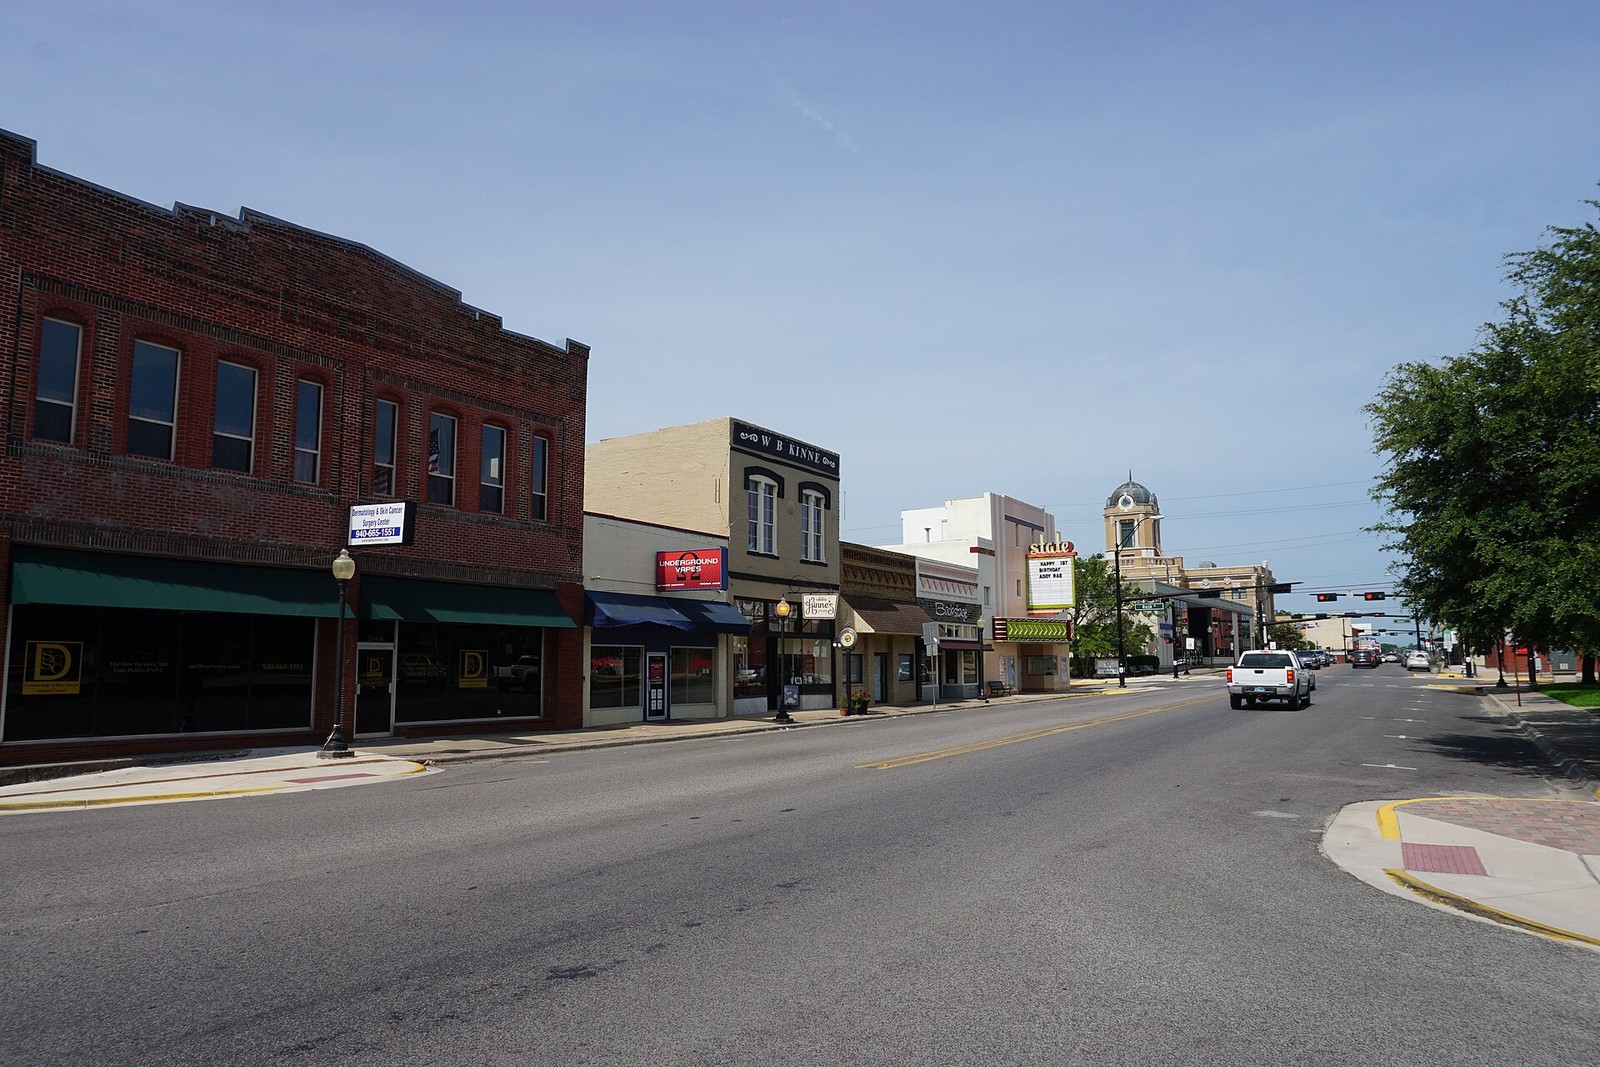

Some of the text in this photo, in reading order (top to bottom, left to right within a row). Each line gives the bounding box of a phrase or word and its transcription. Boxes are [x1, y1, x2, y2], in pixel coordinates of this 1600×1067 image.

[760, 435, 821, 464] W B KINNE
[352, 509, 375, 517] Dermatology
[380, 507, 388, 515] Skin
[389, 506, 403, 514] Cancer
[363, 518, 390, 528] Surgery Center
[355, 528, 396, 538] 940-665-1551
[659, 557, 719, 567] UNDERGROUND
[675, 565, 702, 573] VAPES
[805, 597, 835, 615] Kinne's
[34, 643, 72, 681] D
[464, 652, 483, 678] D
